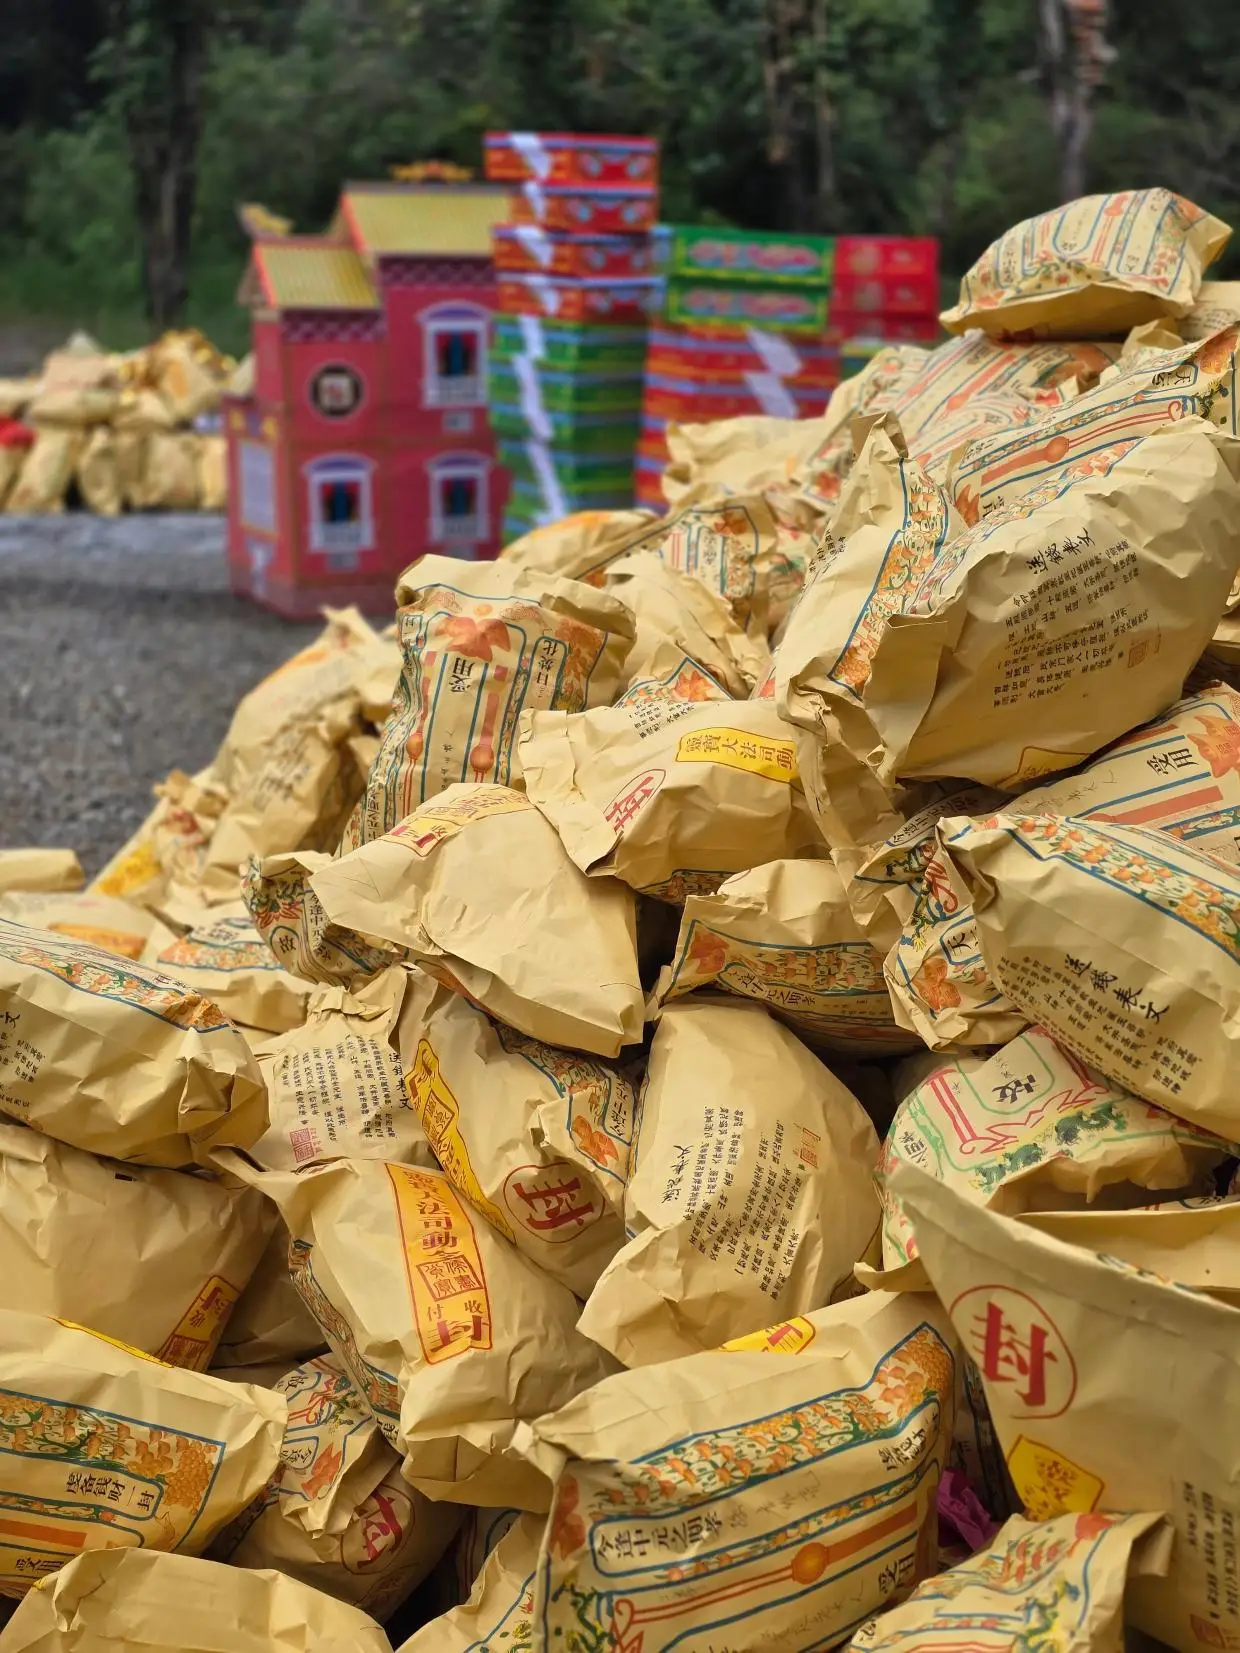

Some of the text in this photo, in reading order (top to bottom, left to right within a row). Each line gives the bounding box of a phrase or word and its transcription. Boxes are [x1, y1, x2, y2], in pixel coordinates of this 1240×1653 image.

[1147, 748, 1200, 776] 受用
[515, 1176, 595, 1231] 封
[971, 1301, 1058, 1407] 封
